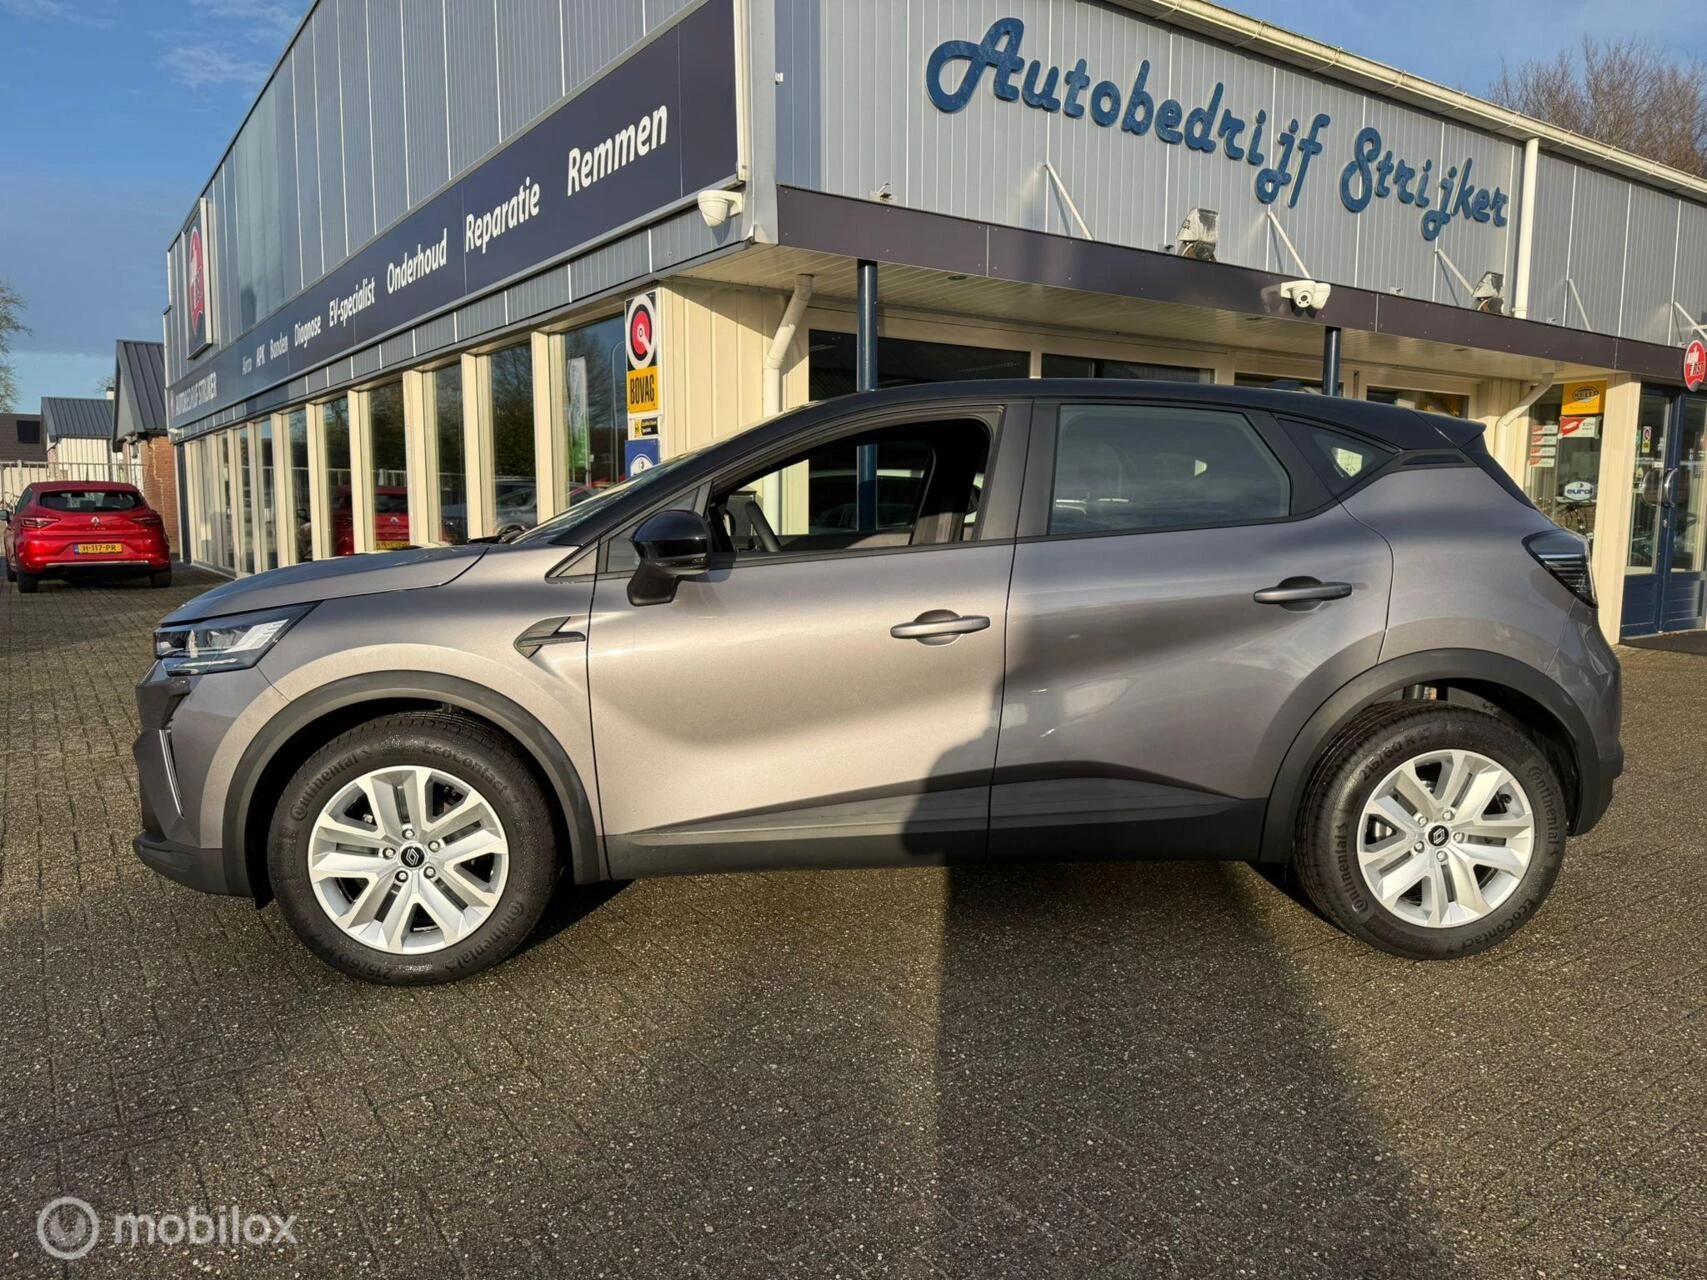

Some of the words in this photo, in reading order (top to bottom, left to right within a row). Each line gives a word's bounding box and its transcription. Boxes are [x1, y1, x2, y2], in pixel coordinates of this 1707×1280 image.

[924, 16, 1331, 208] Autobedrijf
[1340, 126, 1509, 241] Strijker
[294, 315, 321, 348] Diagnose
[328, 275, 376, 328] EV-specialist
[386, 227, 448, 295] Onderhoud
[465, 176, 540, 254] Reparatie
[567, 105, 668, 197] Remmen
[630, 375, 655, 405] BOVAG
[1567, 487, 1593, 496] eurol
[82, 544, 117, 552] H-117-PR
